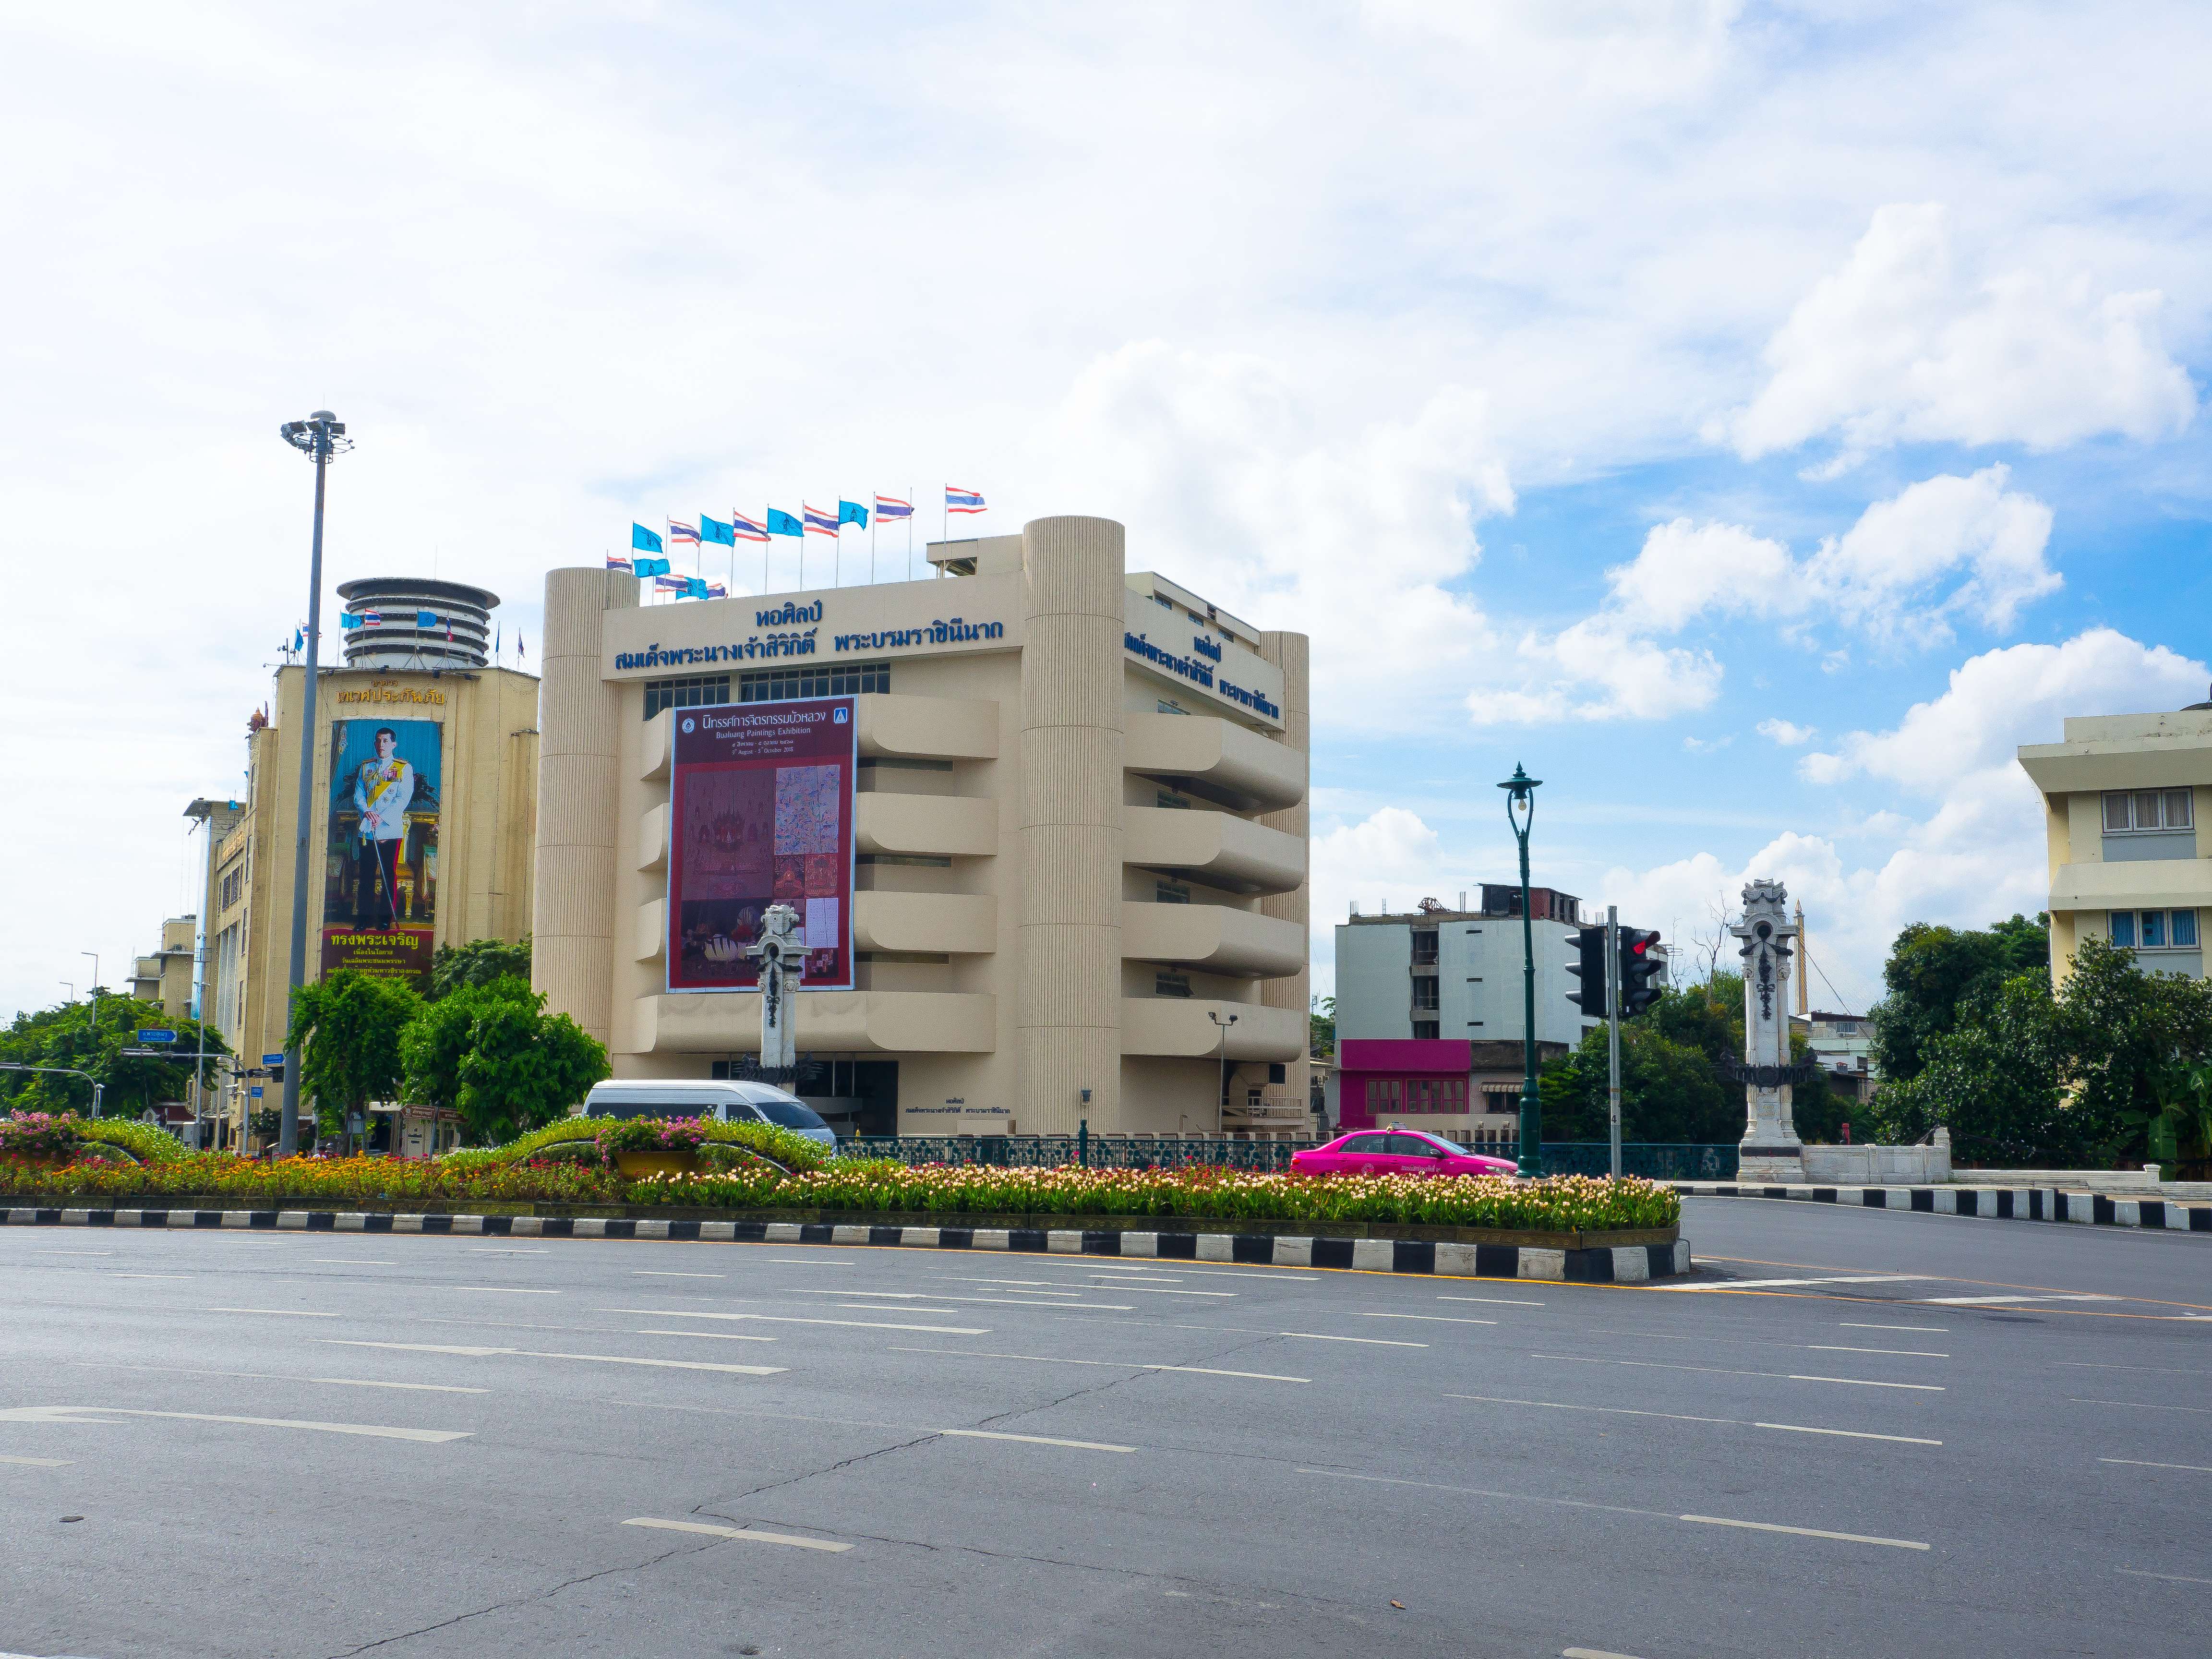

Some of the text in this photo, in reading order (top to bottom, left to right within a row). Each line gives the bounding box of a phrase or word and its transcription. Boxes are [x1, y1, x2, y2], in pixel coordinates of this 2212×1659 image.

[756, 599, 822, 626] หอศิลป์
[615, 617, 1003, 670] สมเด็จพระนางเจ้าสิริกิติ์ พระบรมราชินีนาถ
[702, 710, 826, 729] นิทรรศการจิตรกรรมบัวหลวง
[716, 727, 811, 739] Bualuang Paintings Exhibition
[331, 932, 419, 950] ทรงพระเจริญ
